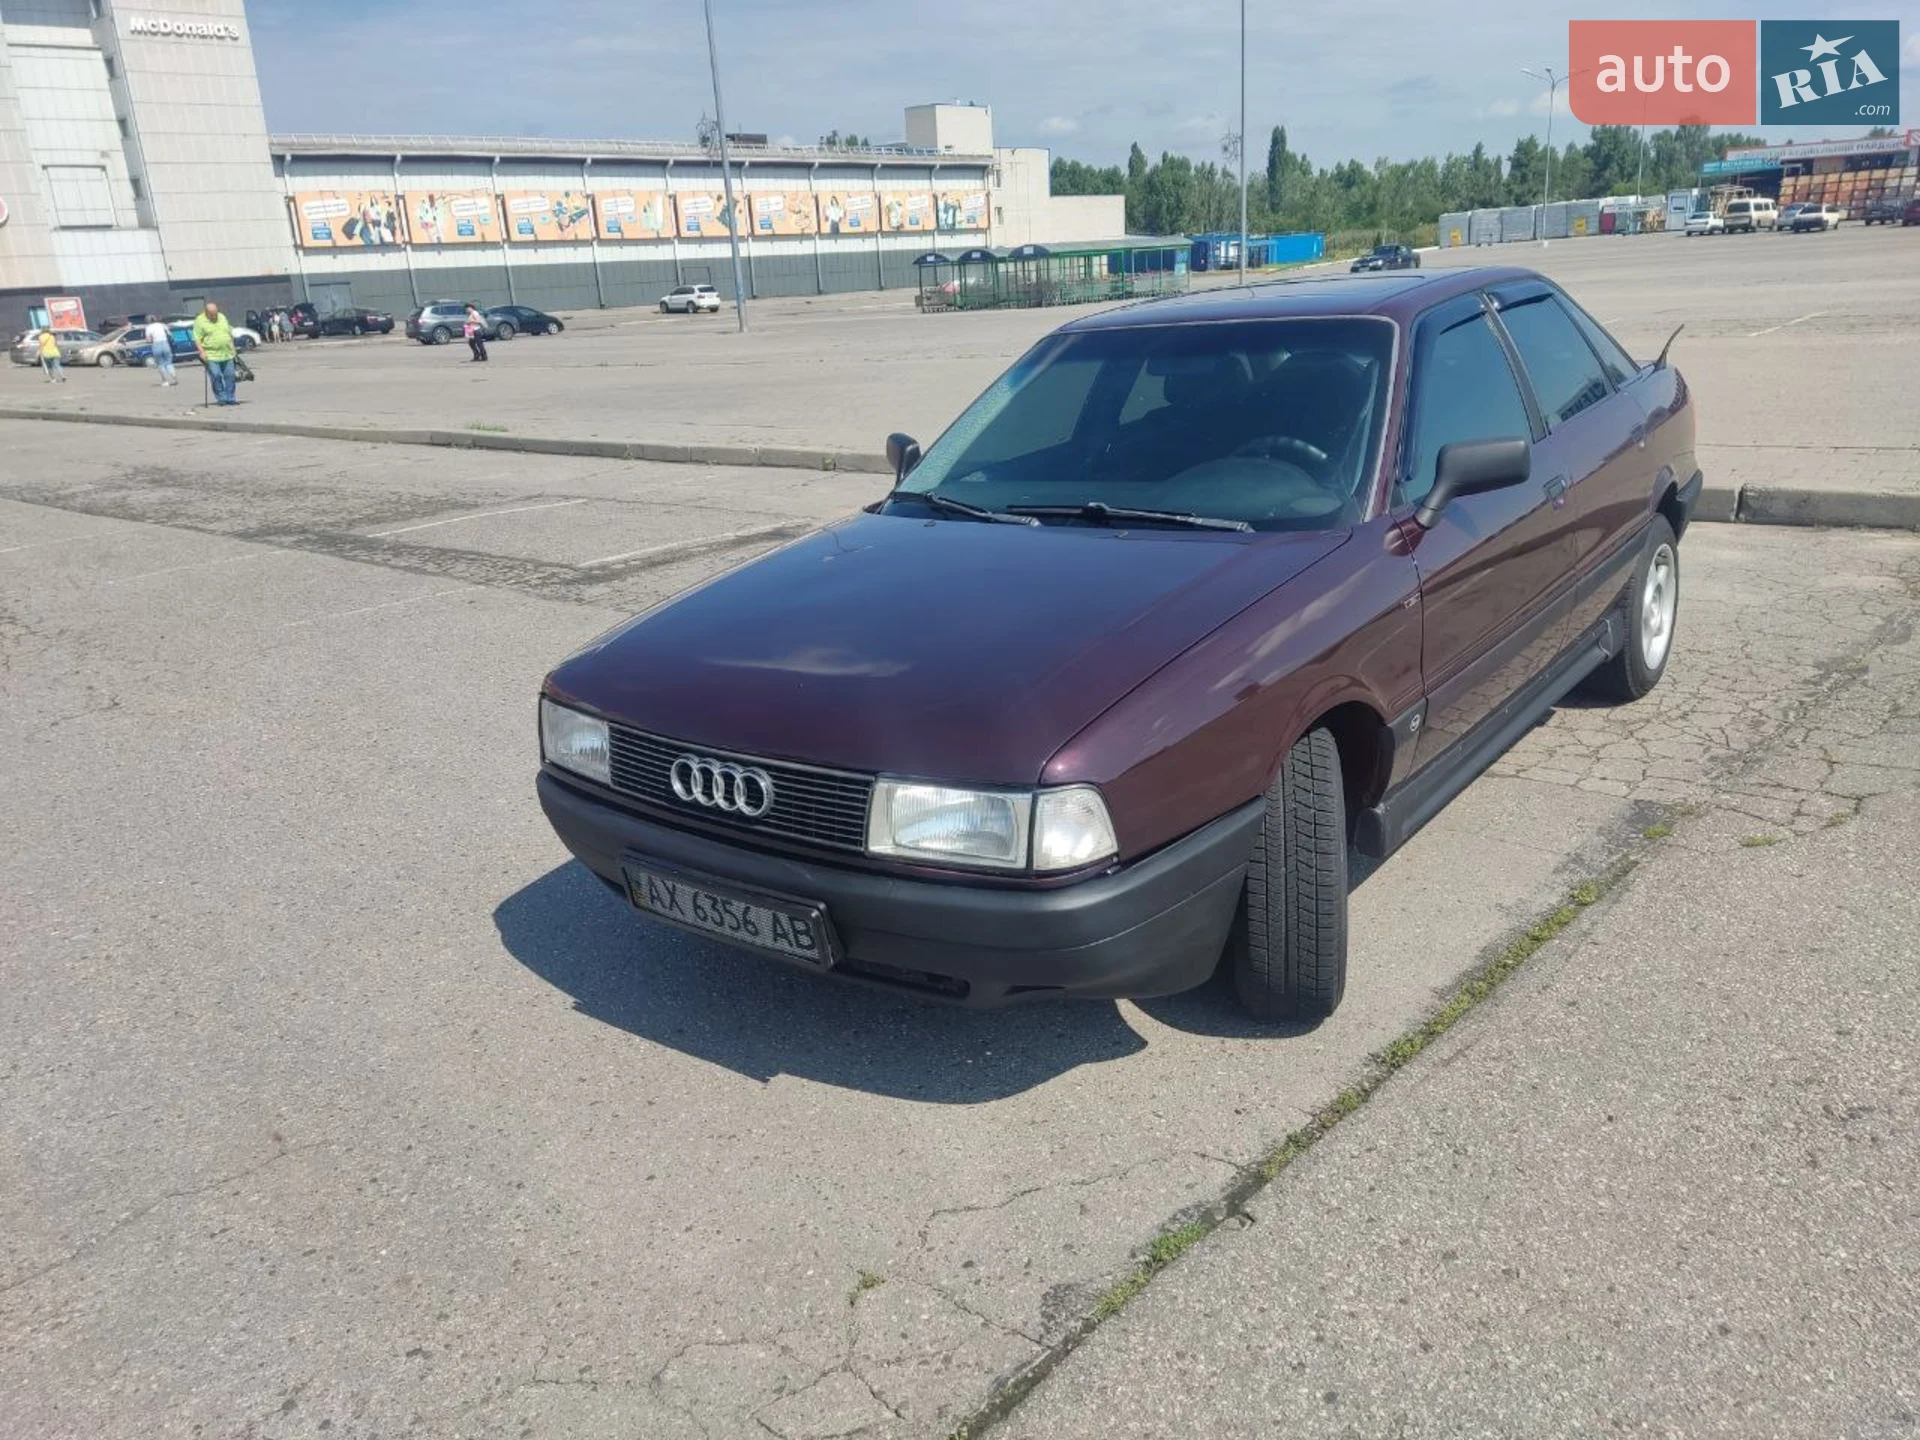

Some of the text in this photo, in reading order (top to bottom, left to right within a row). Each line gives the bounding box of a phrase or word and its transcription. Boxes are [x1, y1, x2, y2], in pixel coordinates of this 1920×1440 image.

[131, 17, 239, 40] McDonald's
[648, 876, 814, 950] AX 6356 AB
